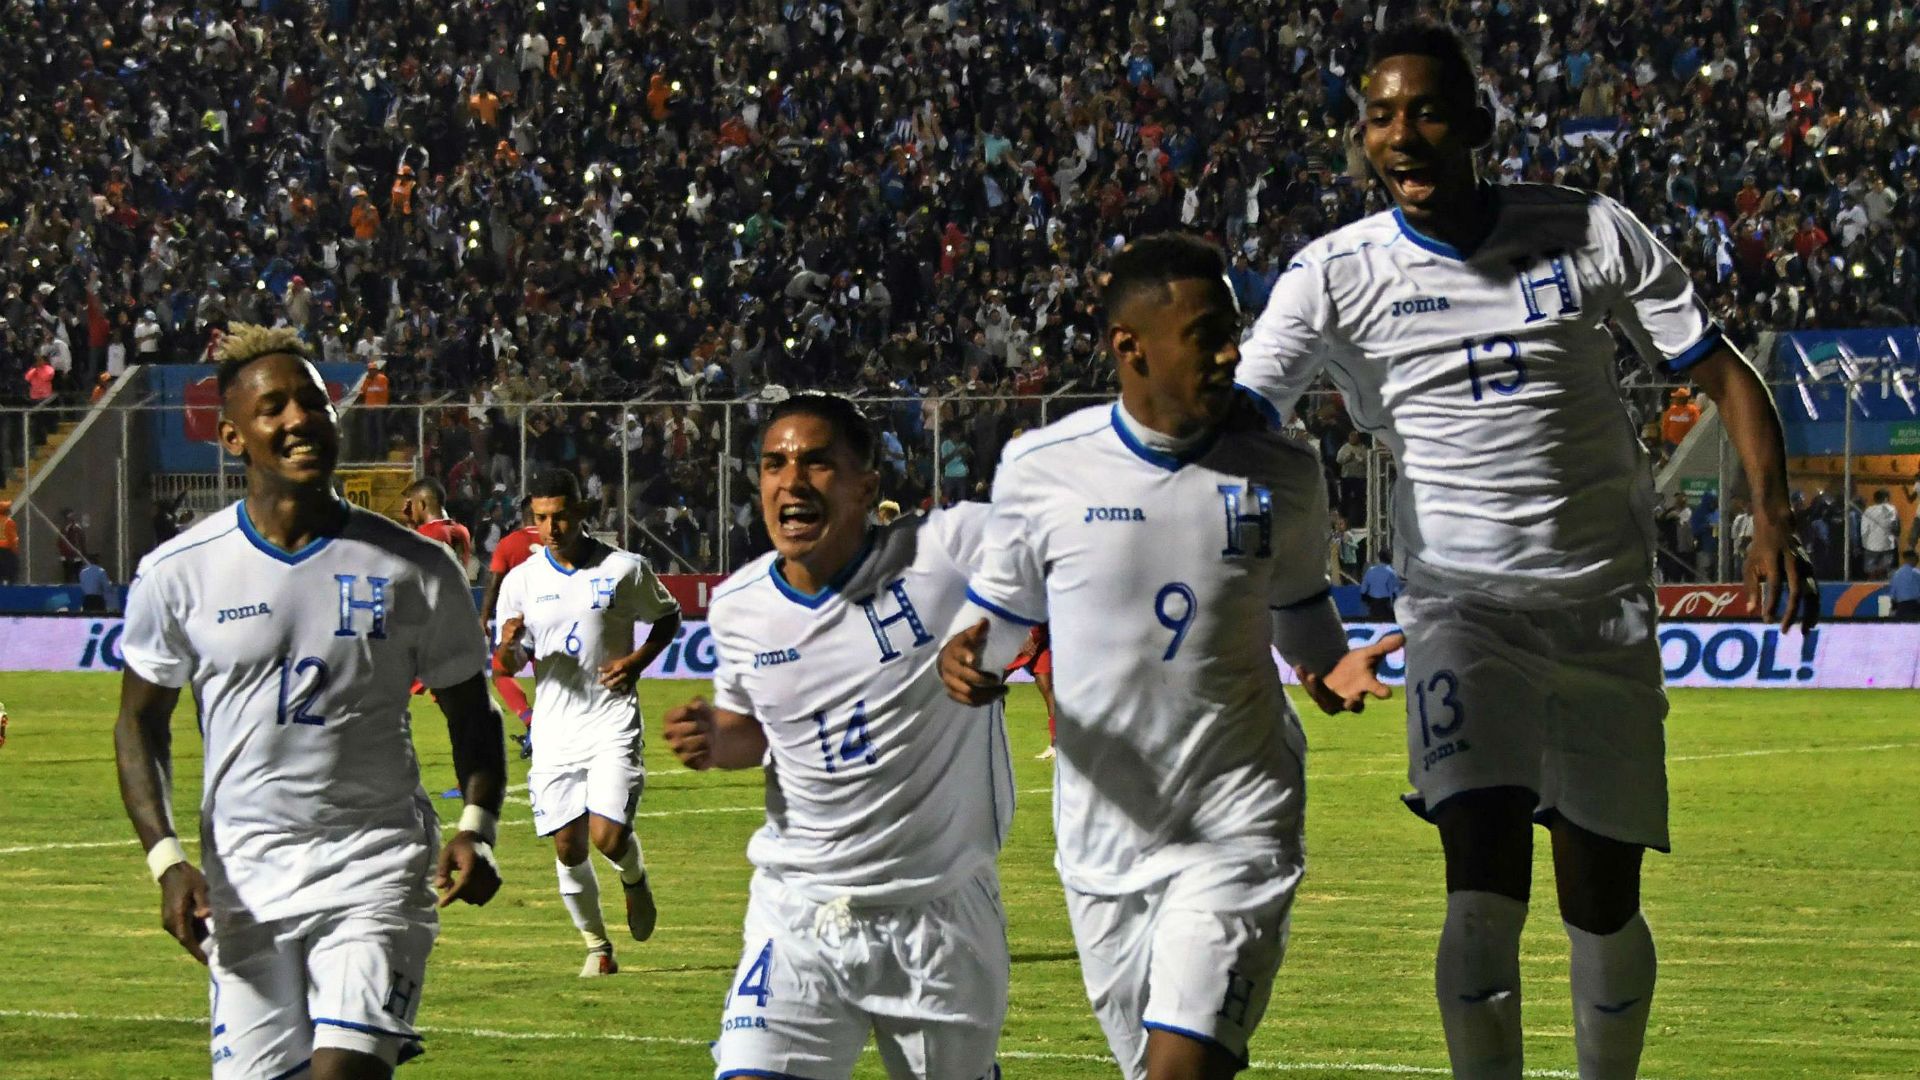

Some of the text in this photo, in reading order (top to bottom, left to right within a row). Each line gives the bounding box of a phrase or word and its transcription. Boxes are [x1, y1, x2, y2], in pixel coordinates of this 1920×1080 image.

[1510, 247, 1581, 324] H
[1462, 334, 1528, 402] 13
[1217, 484, 1273, 559] H
[334, 574, 389, 640] H
[590, 577, 616, 610] H
[853, 577, 935, 664] H
[1154, 581, 1198, 662] 9
[565, 621, 582, 656] 6
[276, 655, 331, 726] 12
[1416, 669, 1465, 749] 13
[813, 699, 878, 773] 14
[729, 937, 774, 1008] 4
[724, 1016, 769, 1031] oma
